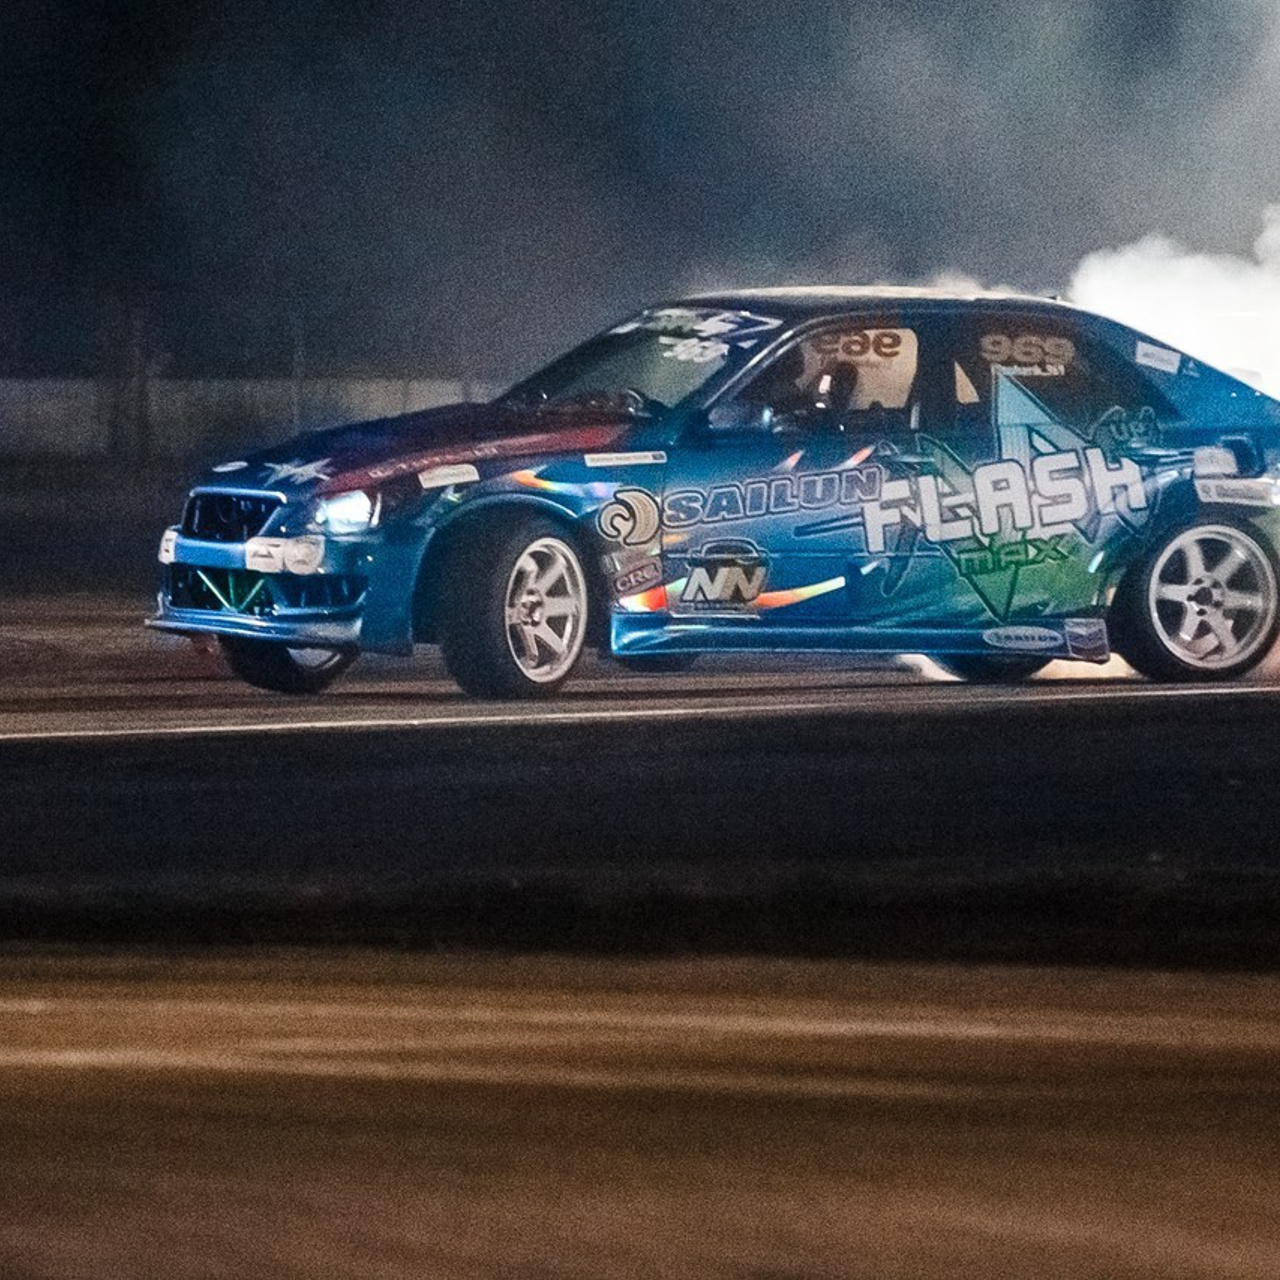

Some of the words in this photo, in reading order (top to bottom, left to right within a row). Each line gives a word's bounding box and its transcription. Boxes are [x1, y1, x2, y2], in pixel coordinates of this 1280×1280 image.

[980, 334, 1075, 364] 969
[661, 464, 886, 528] SAILUN
[861, 447, 1149, 554] FLASH
